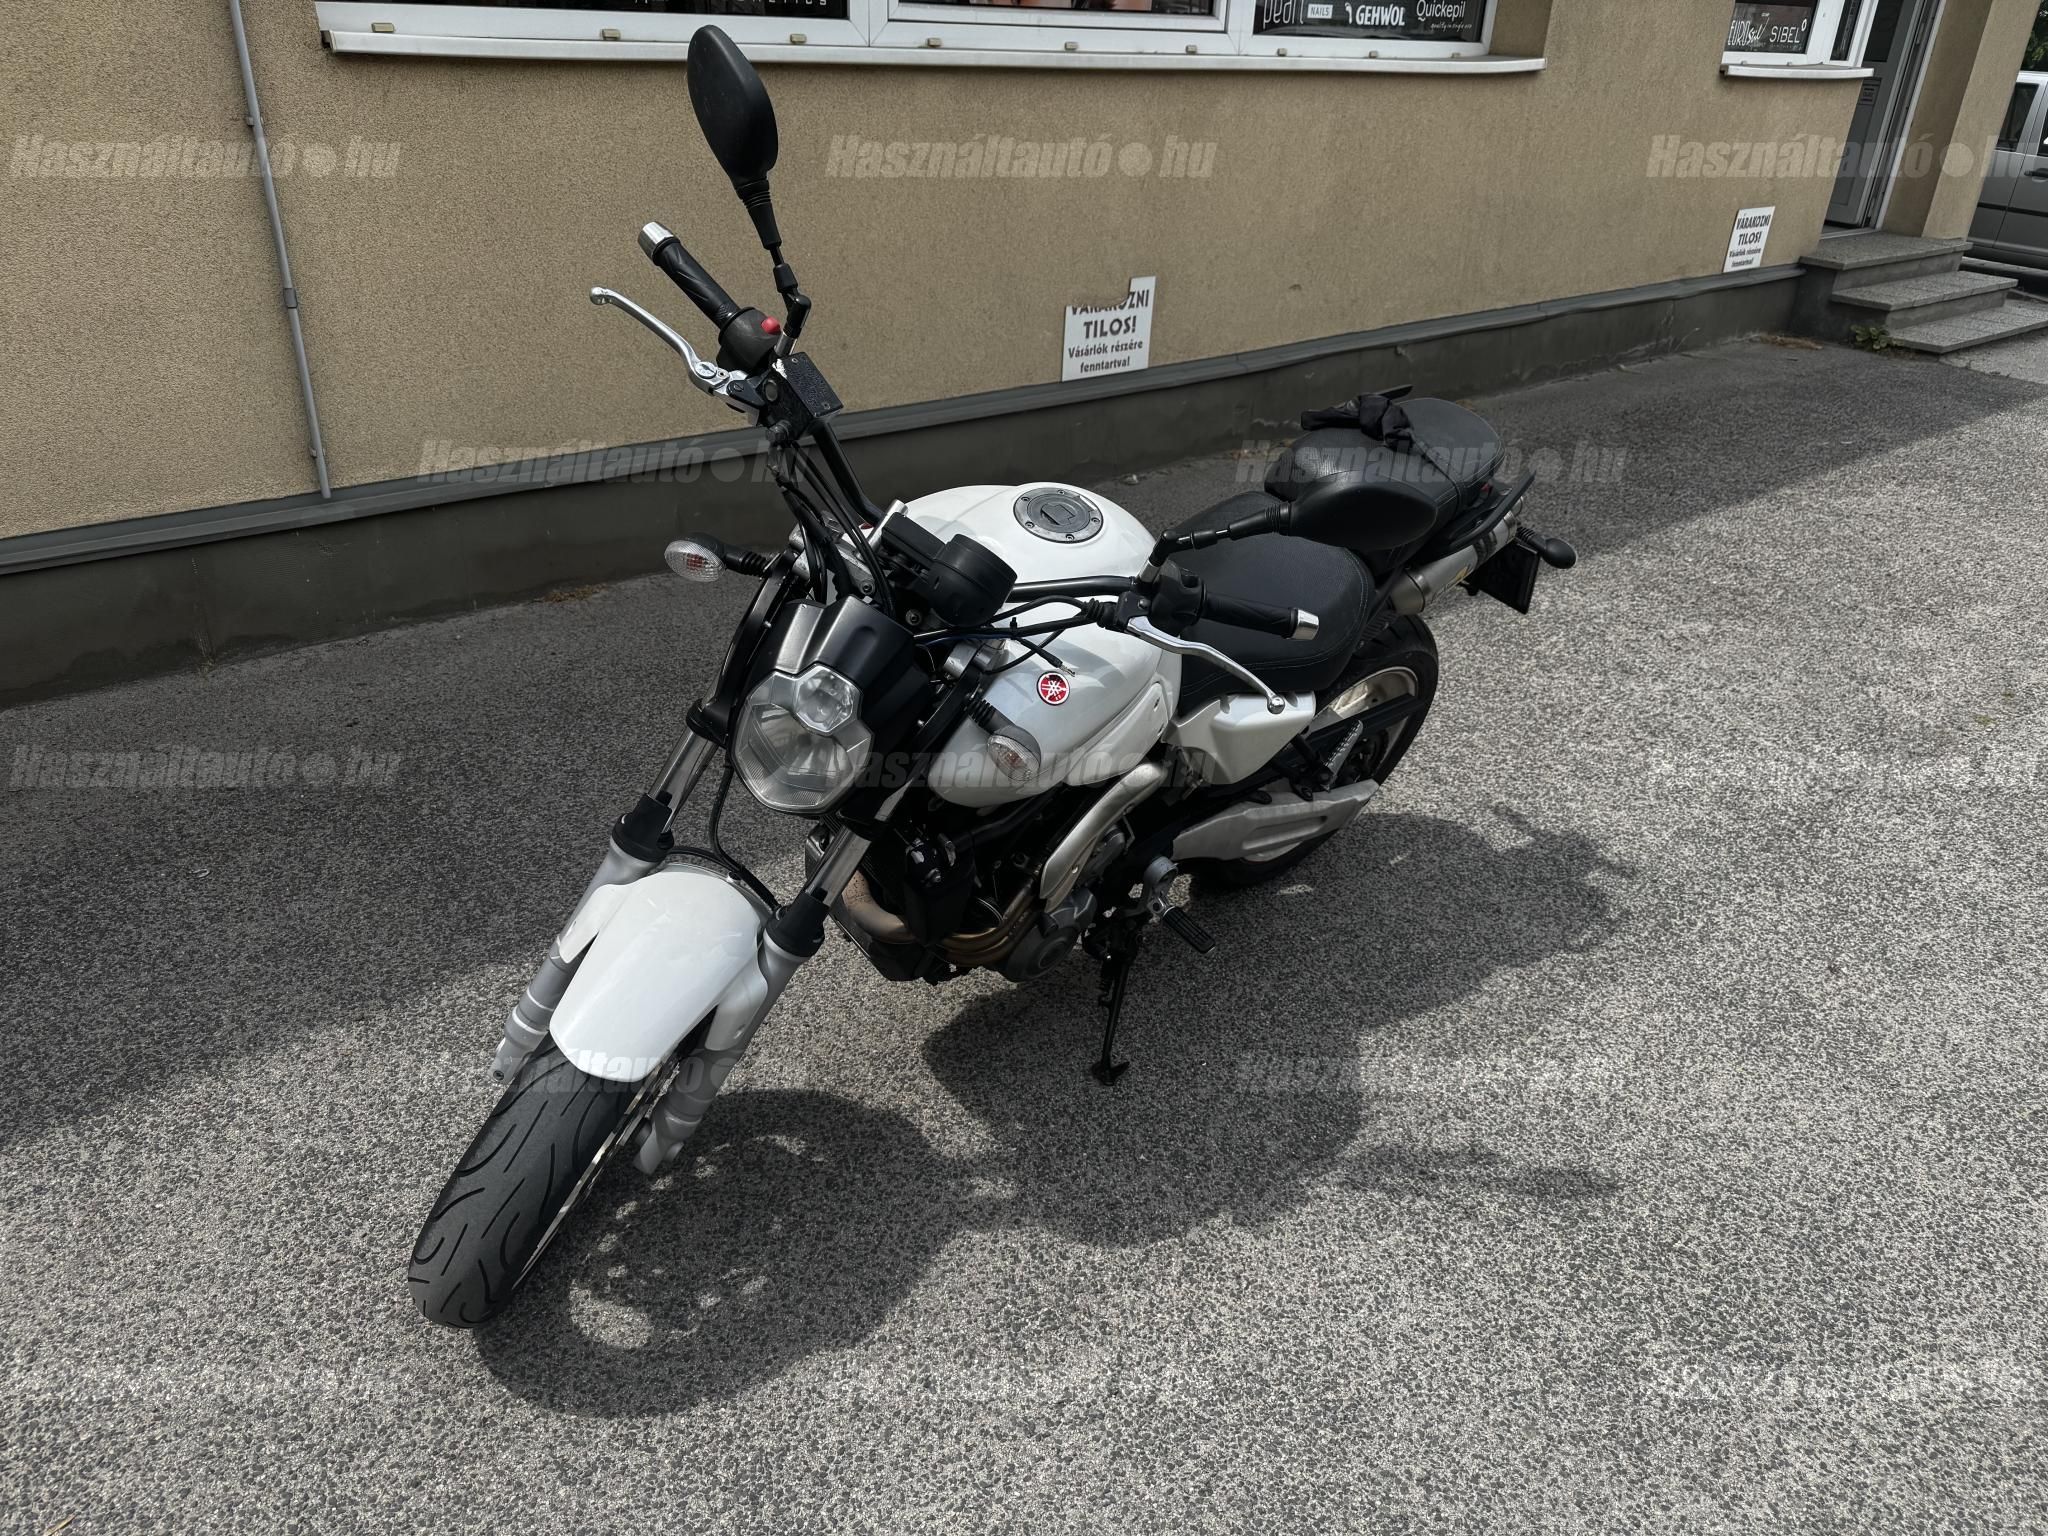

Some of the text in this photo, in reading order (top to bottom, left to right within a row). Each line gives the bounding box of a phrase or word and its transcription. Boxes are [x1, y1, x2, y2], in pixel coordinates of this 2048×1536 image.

[1310, 6, 1329, 16] NAILS
[1355, 4, 1405, 26] GEHWOL
[1416, 0, 1466, 21] Quickepil
[1769, 25, 1801, 44] SIBEL
[1083, 315, 1137, 339] TILOS!
[1068, 339, 1143, 359] Vásárlók részére
